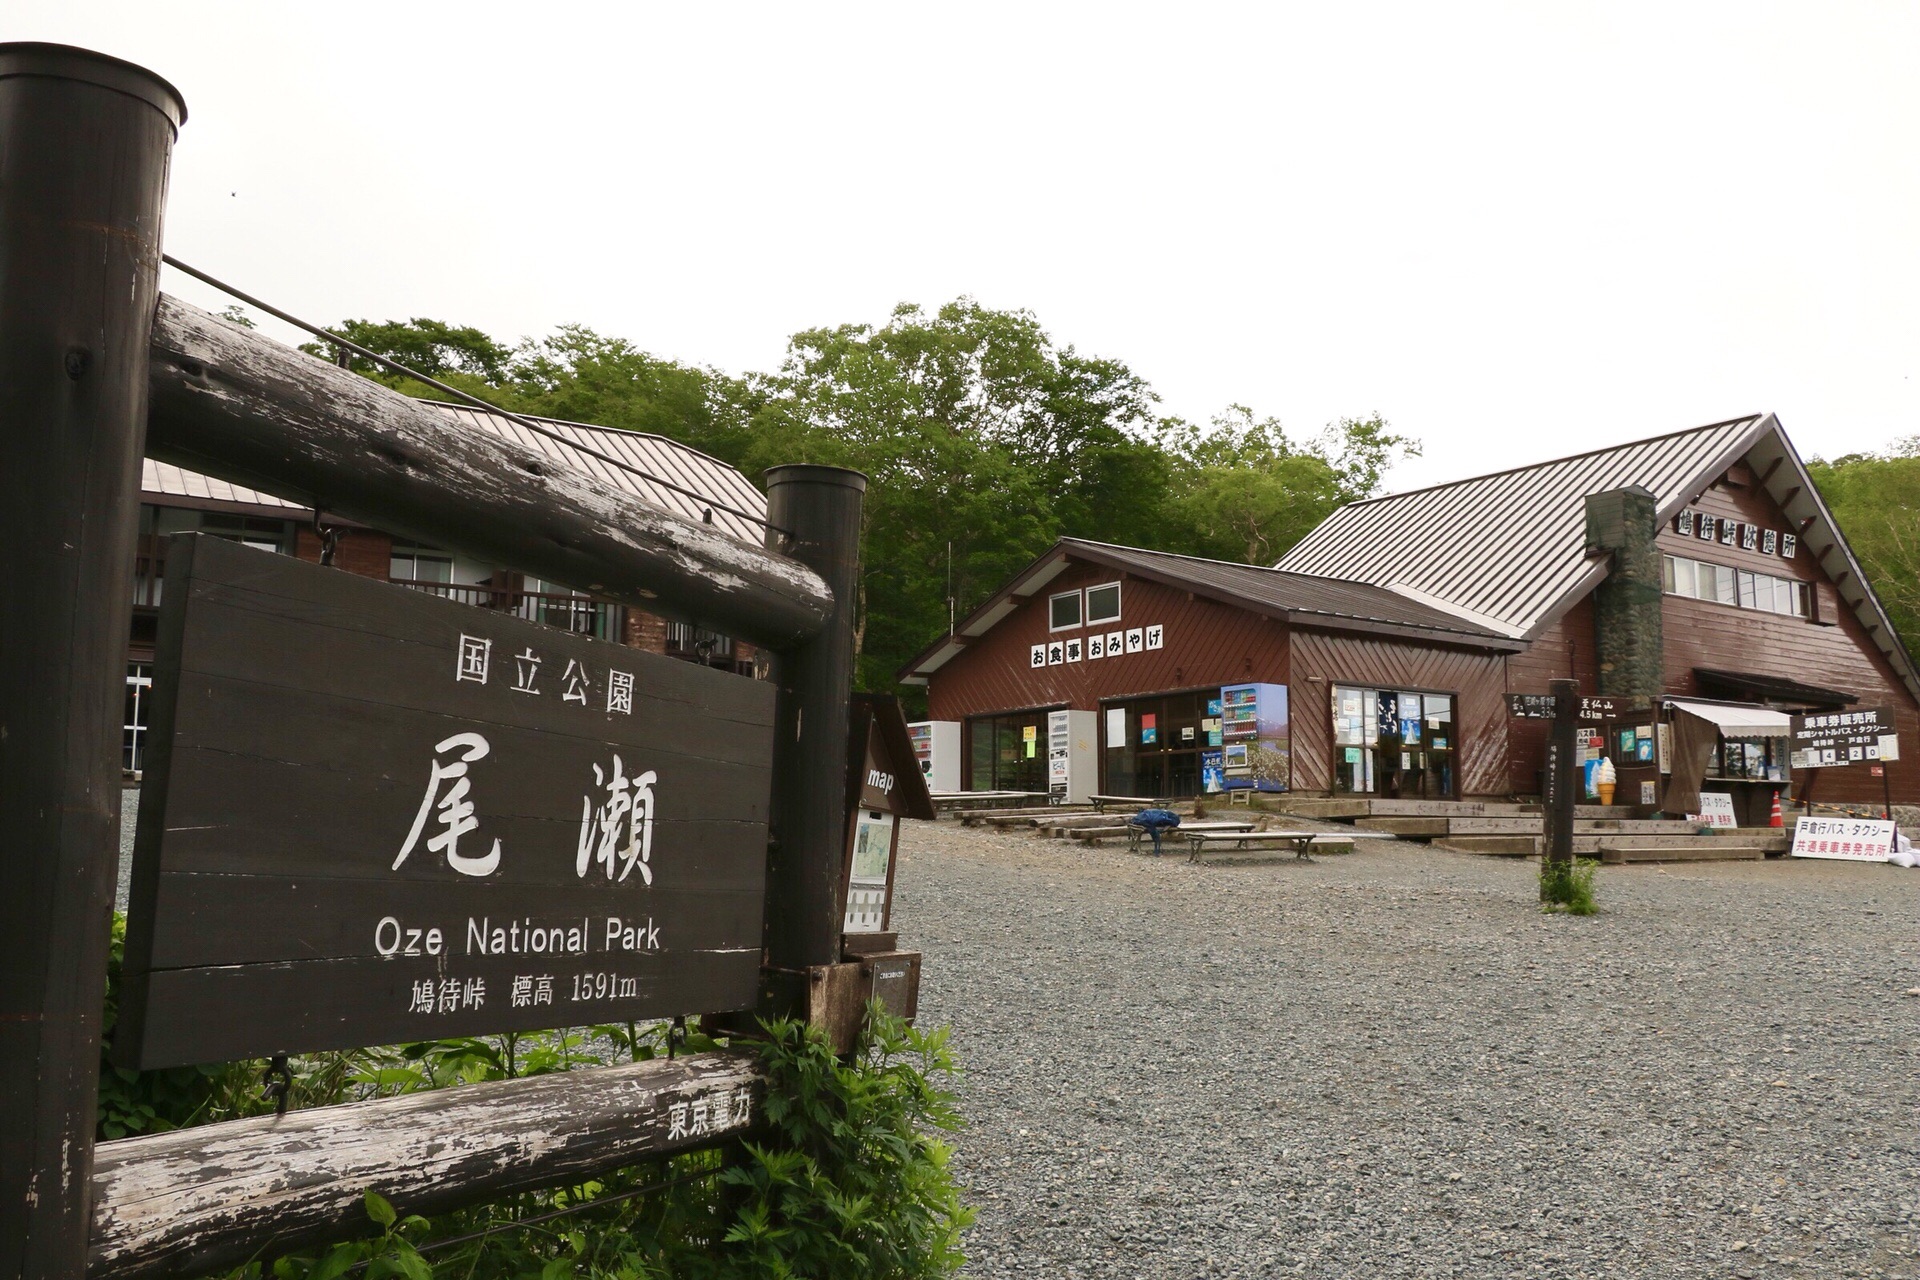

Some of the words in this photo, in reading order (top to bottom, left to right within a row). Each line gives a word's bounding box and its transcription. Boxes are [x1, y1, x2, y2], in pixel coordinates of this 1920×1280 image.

[1678, 508, 1796, 559] 鳩待峠休憩所
[1033, 643, 1080, 663] お食事
[1091, 628, 1161, 656] おみやげ
[456, 632, 636, 715] 国立公園
[1579, 710, 1592, 719] 4.5
[1592, 710, 1603, 719] km
[1581, 698, 1614, 710] 至仏山
[1796, 725, 1888, 739] 定期シャトルバス・タクシー
[1804, 711, 1877, 729] 乗車券販売所
[867, 768, 895, 796] map
[391, 732, 658, 886] 尾瀬
[1799, 821, 1890, 837] 戸倉行バス・タクシー
[1796, 840, 1887, 858] 共通乗車券発売所
[374, 915, 443, 957] Oze
[467, 916, 588, 956] National
[605, 916, 661, 952] Park
[408, 976, 486, 1013] 鳩待峠
[510, 974, 555, 1008] 標高
[570, 972, 637, 1001] 1591m
[667, 1090, 752, 1142] 東京電力
